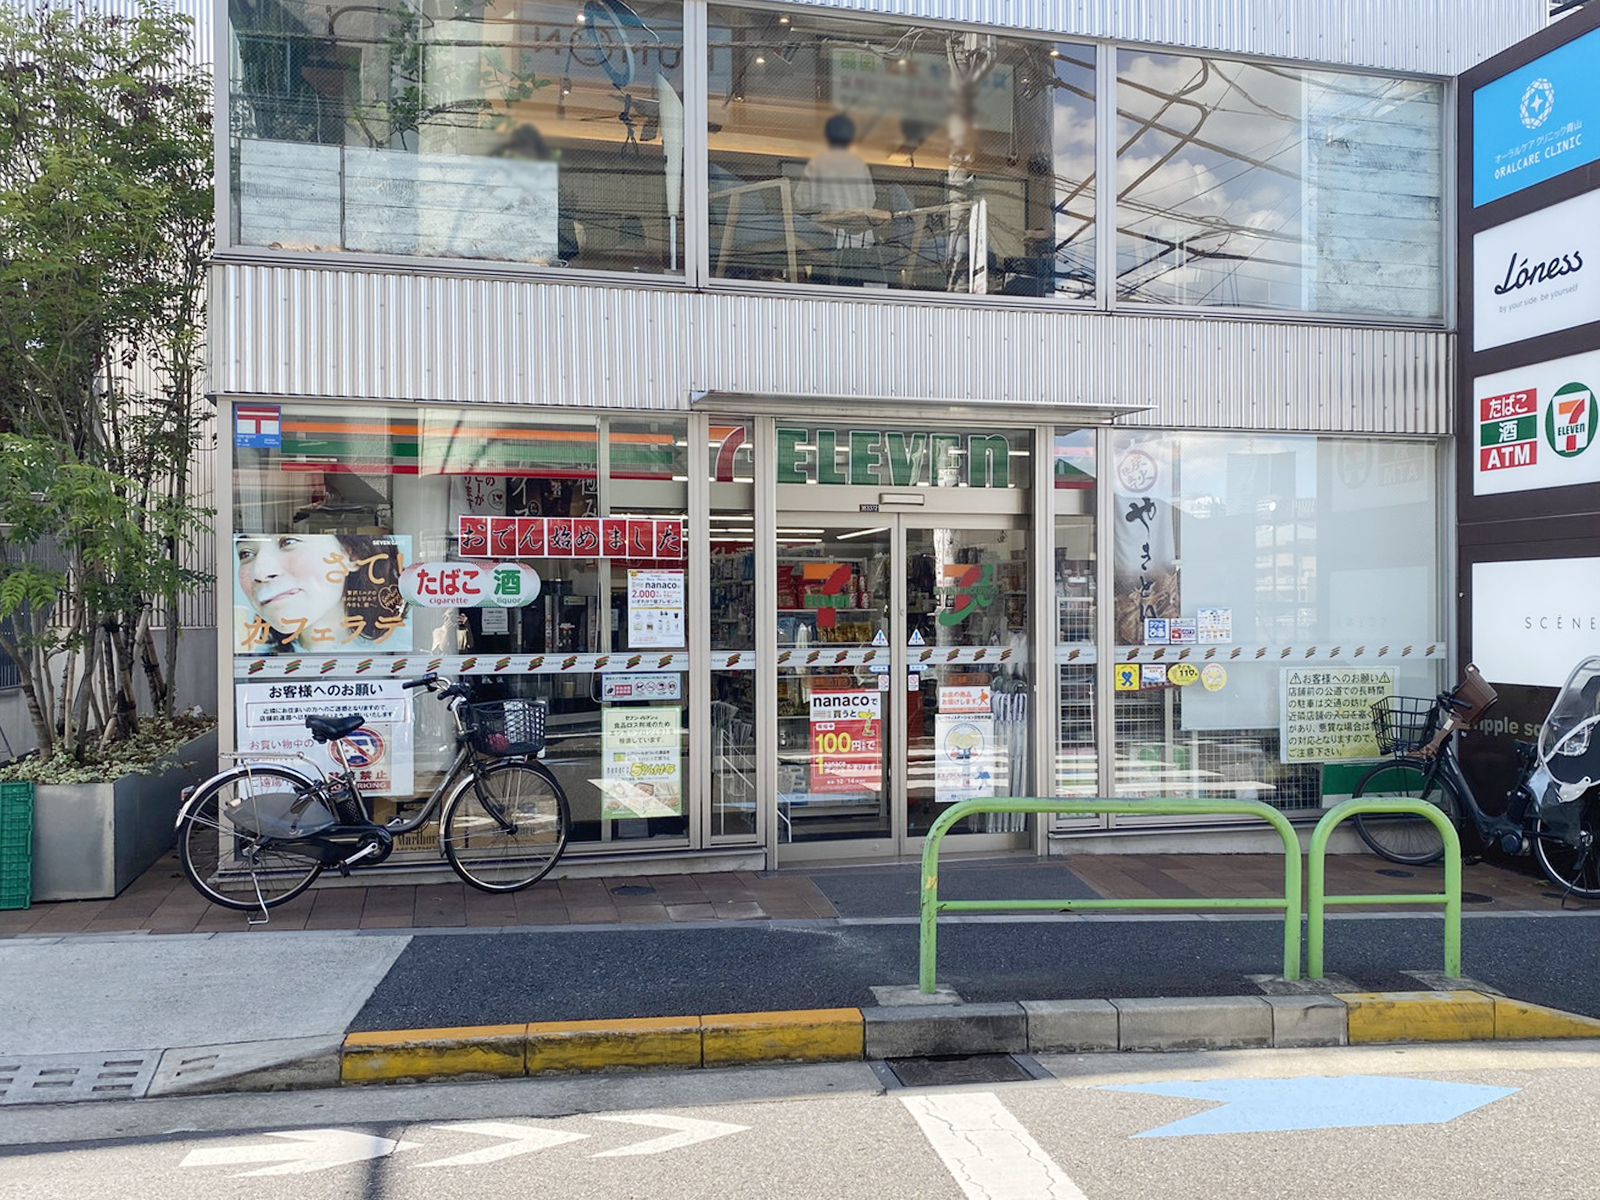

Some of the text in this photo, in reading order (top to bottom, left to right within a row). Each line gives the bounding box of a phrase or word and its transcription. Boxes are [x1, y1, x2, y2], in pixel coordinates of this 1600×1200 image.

[1494, 133, 1583, 180] ORALCARE CLINIC
[1509, 300, 1523, 312] your
[1550, 283, 1579, 300] yourself
[1489, 394, 1528, 419] たばこ
[1499, 420, 1518, 443] 酒
[1487, 444, 1530, 469] ATM
[462, 524, 681, 551] おでん始めました
[417, 568, 521, 595] たばこ 酒
[496, 597, 522, 605] liquor
[241, 615, 405, 645] カフェラテ
[1303, 672, 1379, 684] お客様へのお願い
[269, 683, 383, 699] お客様へのお願い
[1288, 686, 1385, 697] 店舗前の公道での長時間
[1288, 698, 1371, 708] の駐車は交通の妨げ
[833, 710, 857, 719] 買うと
[1288, 722, 1375, 733] があり、悪質な場合は
[249, 738, 315, 749] お買い物中の
[1288, 734, 1374, 746] の対応となりますので、
[1288, 747, 1342, 758] ご注意下さい。
